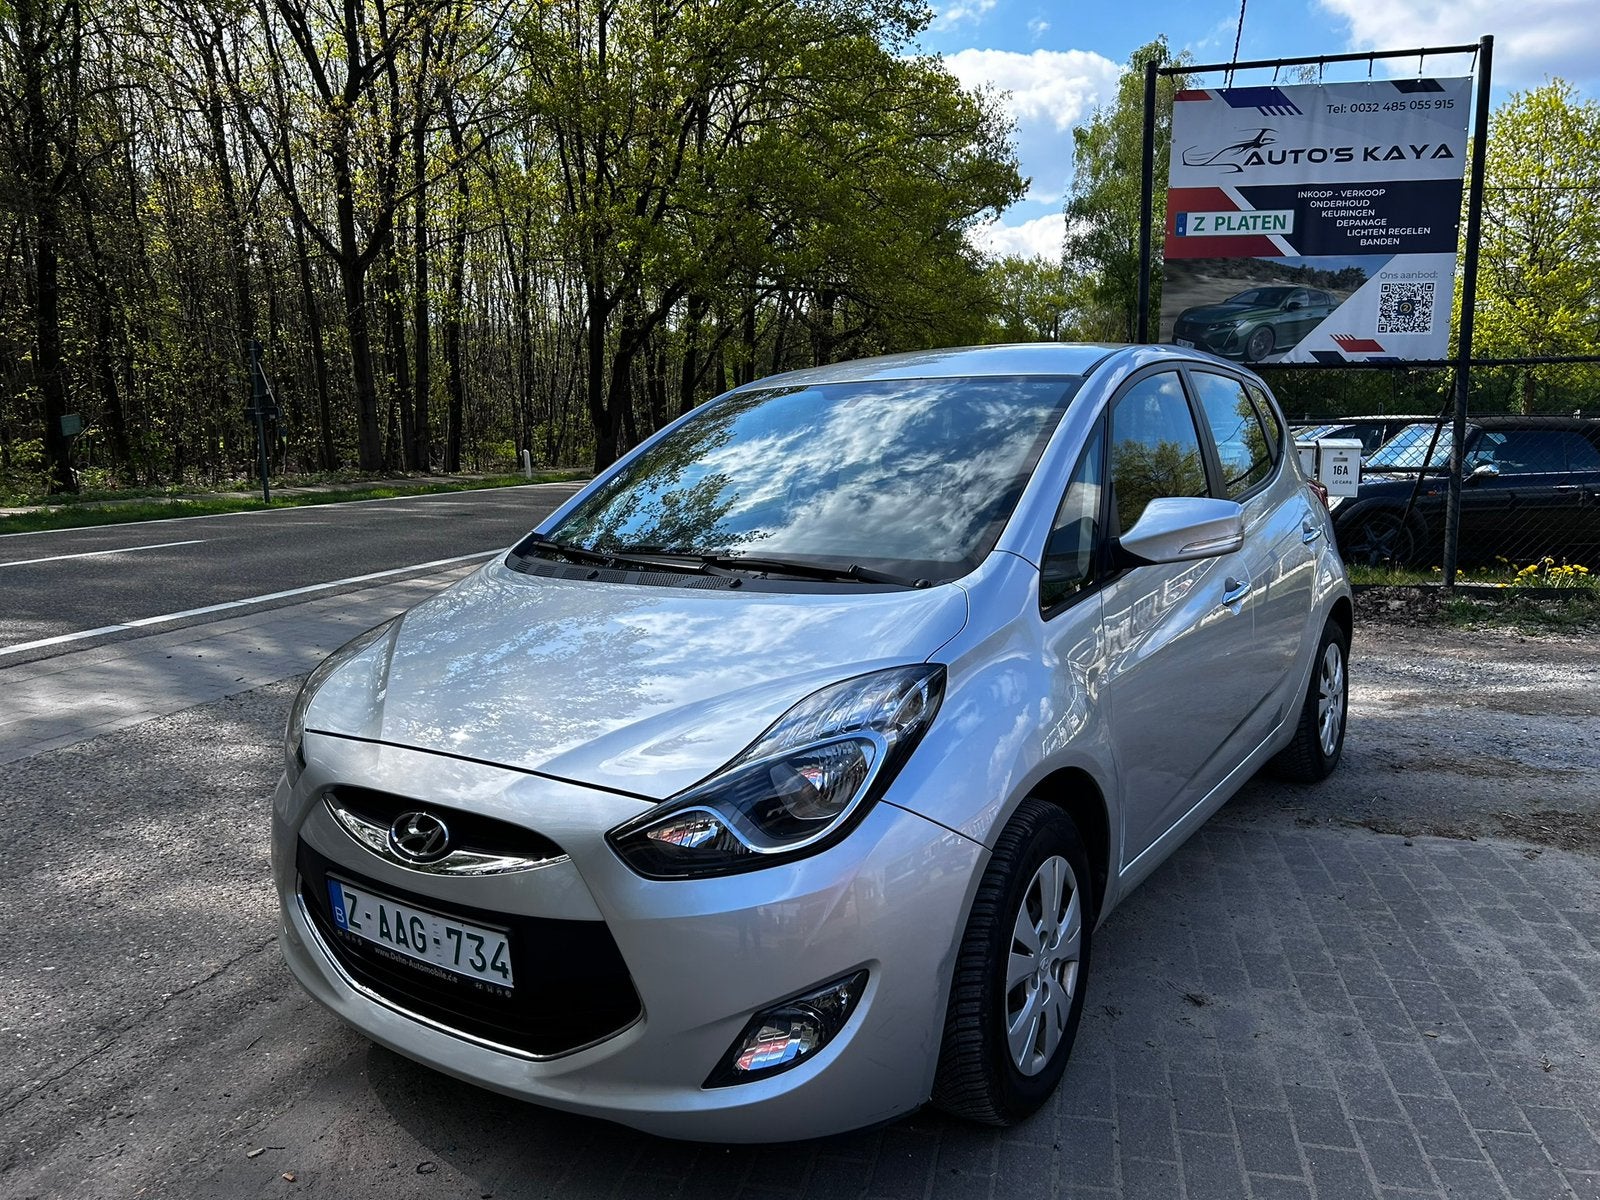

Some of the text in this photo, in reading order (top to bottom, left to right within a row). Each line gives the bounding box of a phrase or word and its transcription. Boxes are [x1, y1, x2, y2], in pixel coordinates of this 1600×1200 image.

[1327, 99, 1454, 114] Tel: 0032 485 055 915
[1243, 143, 1454, 166] AUTO'S KAYA
[1341, 189, 1386, 197] VERKOOP
[1310, 200, 1370, 208] ONDERHOUD
[1321, 209, 1375, 217] KEURINGEN
[1193, 215, 1286, 231] Z PLATEN
[1336, 219, 1387, 227] DEPANAGE
[1347, 227, 1430, 236] LICHTEN REGELEN
[1360, 238, 1400, 246] BANDEN
[1400, 271, 1438, 279] aanbod:
[1333, 465, 1348, 475] 16A
[335, 906, 345, 924] B
